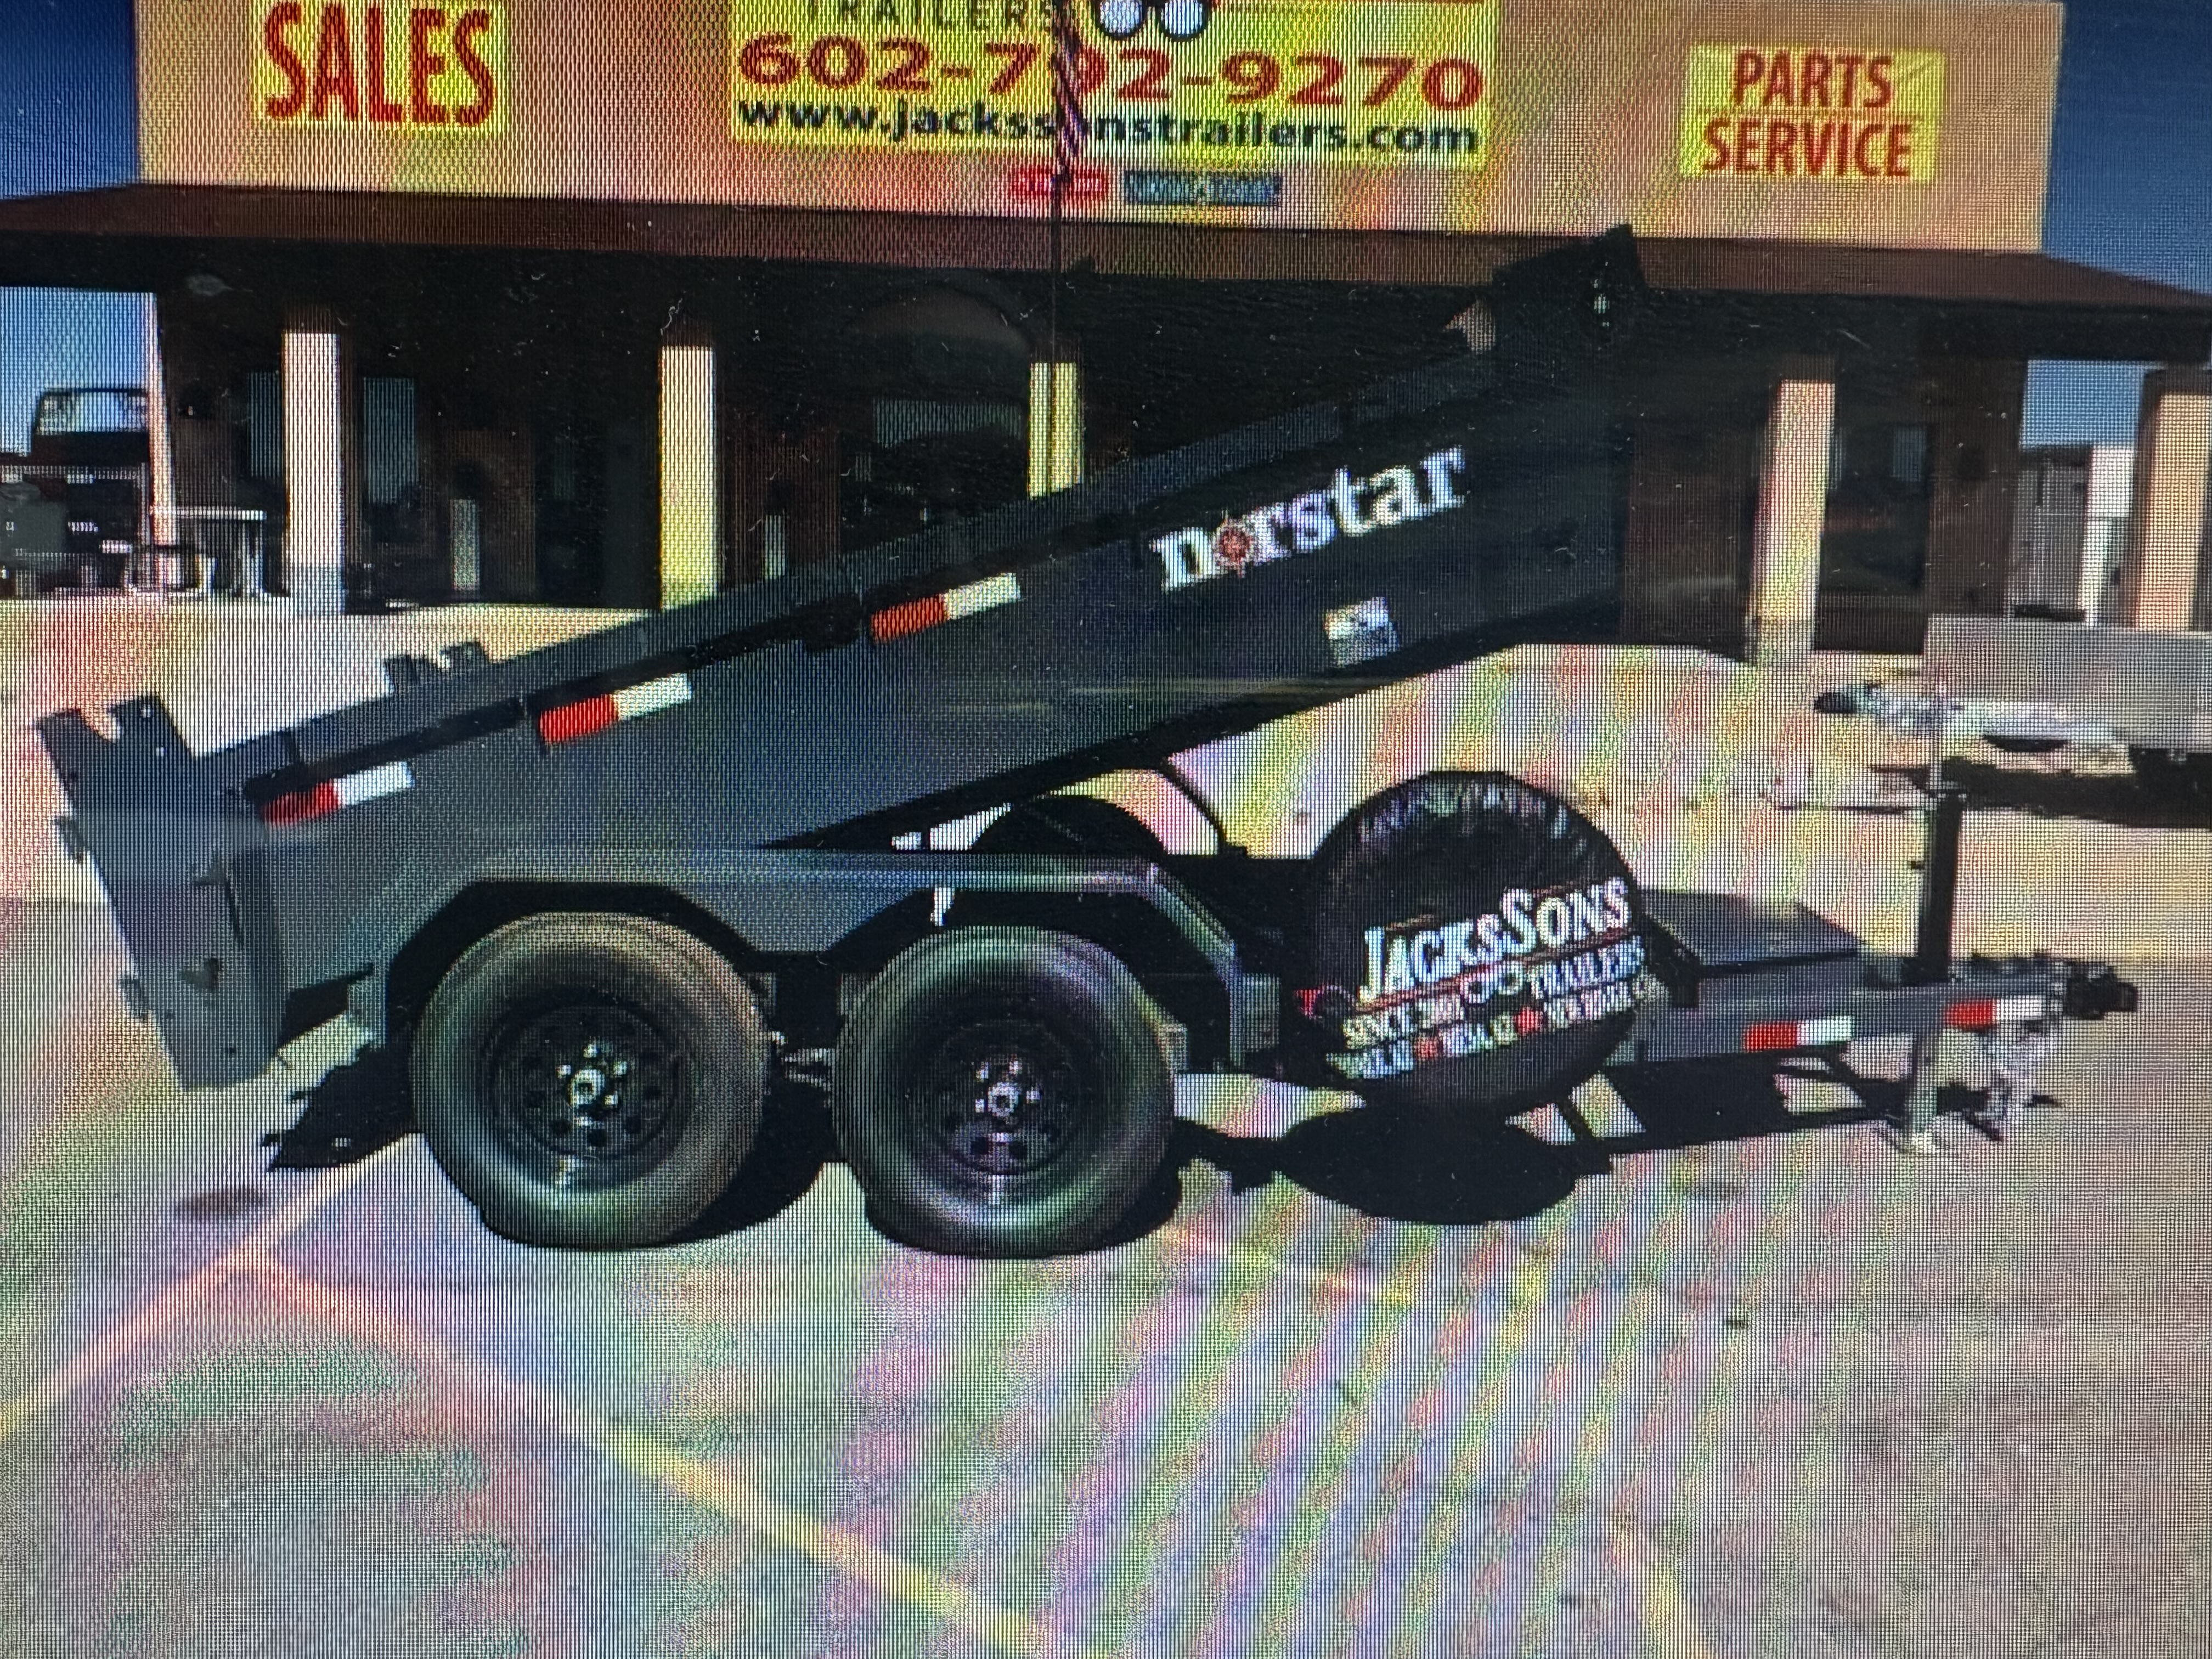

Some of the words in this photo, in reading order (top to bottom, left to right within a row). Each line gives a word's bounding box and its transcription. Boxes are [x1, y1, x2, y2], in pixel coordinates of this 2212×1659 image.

[264, 1, 495, 126] SALES
[1733, 47, 1893, 109] PARTS
[738, 98, 1479, 154] www.jackssnstrailers.com
[1702, 116, 1914, 177] SERVICE
[1149, 445, 1466, 594] norstar
[1526, 935, 1645, 999] TRAILERS
